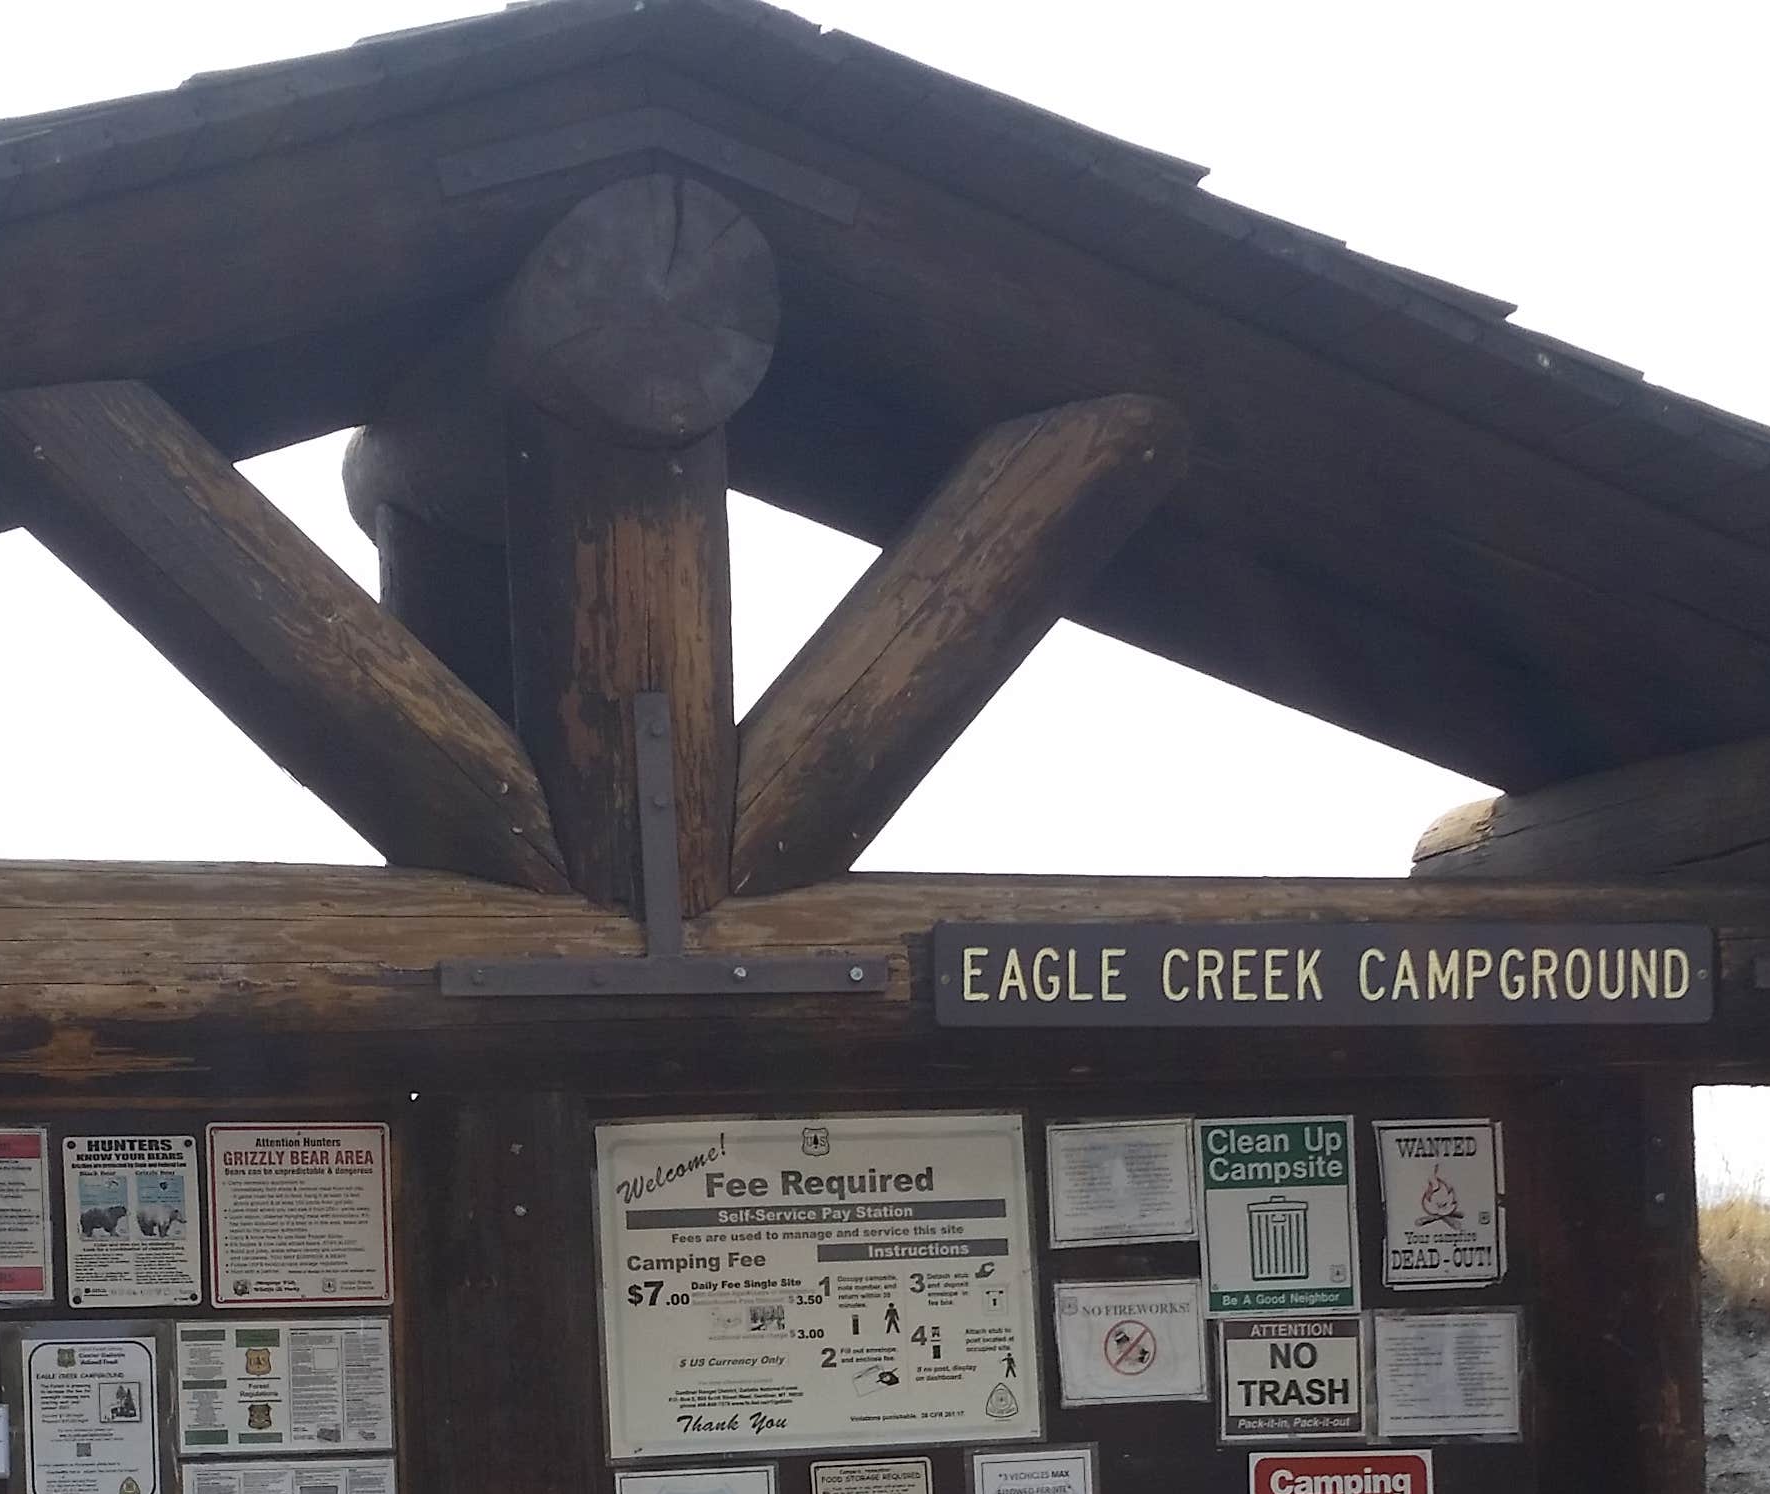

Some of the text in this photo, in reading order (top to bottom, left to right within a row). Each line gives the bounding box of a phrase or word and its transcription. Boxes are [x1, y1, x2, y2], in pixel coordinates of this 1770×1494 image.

[961, 947, 1689, 1003] EAGLE CREEK CAMPGROUND
[87, 1139, 173, 1153] HUNTERS
[255, 1137, 341, 1148] Attention Hunters
[1206, 1126, 1342, 1156] Clean Up
[1395, 1136, 1477, 1159] WANTED
[76, 1152, 184, 1162] KNOW YOUR BEARS
[223, 1150, 374, 1167] GRIZZLY BEAR AREA
[225, 1168, 247, 1176] Bears
[263, 1168, 273, 1176] be
[275, 1168, 325, 1177] unpredictable
[335, 1168, 374, 1177] dangerous
[615, 1132, 725, 1203] Welcome!
[1208, 1155, 1343, 1184] Campsite
[704, 1166, 934, 1200] Fee Required
[718, 1205, 913, 1223] Self-Service Pay Station
[671, 1225, 964, 1244] Fees are used to manage and service this site
[1404, 1230, 1477, 1245] Your campfire
[868, 1243, 970, 1258] Instructions
[1391, 1246, 1492, 1270] DEAD OUT!
[627, 1252, 766, 1273] Camping Fee
[691, 1278, 802, 1291] Daily Fee Single Site
[818, 1276, 830, 1297] 1
[910, 1273, 926, 1293] 3
[627, 1281, 690, 1307] $7.00
[796, 1294, 823, 1305] 3.50
[1222, 1292, 1340, 1306] Be A Good Neighbor
[1083, 1302, 1190, 1316] NO FIREWORKS!
[797, 1328, 825, 1340] 3.00
[910, 1325, 928, 1346] 4
[1250, 1322, 1334, 1337] ATTENTION
[690, 1355, 786, 1368] US Currency Only
[821, 1347, 837, 1368] 2
[1270, 1342, 1318, 1370] NO
[239, 1390, 279, 1399] Regulations
[248, 1383, 270, 1391] Forest
[1237, 1378, 1350, 1407] TRASH
[677, 1411, 788, 1435] Thank You
[1238, 1416, 1350, 1429] Pack-it-in, Pack-it-out
